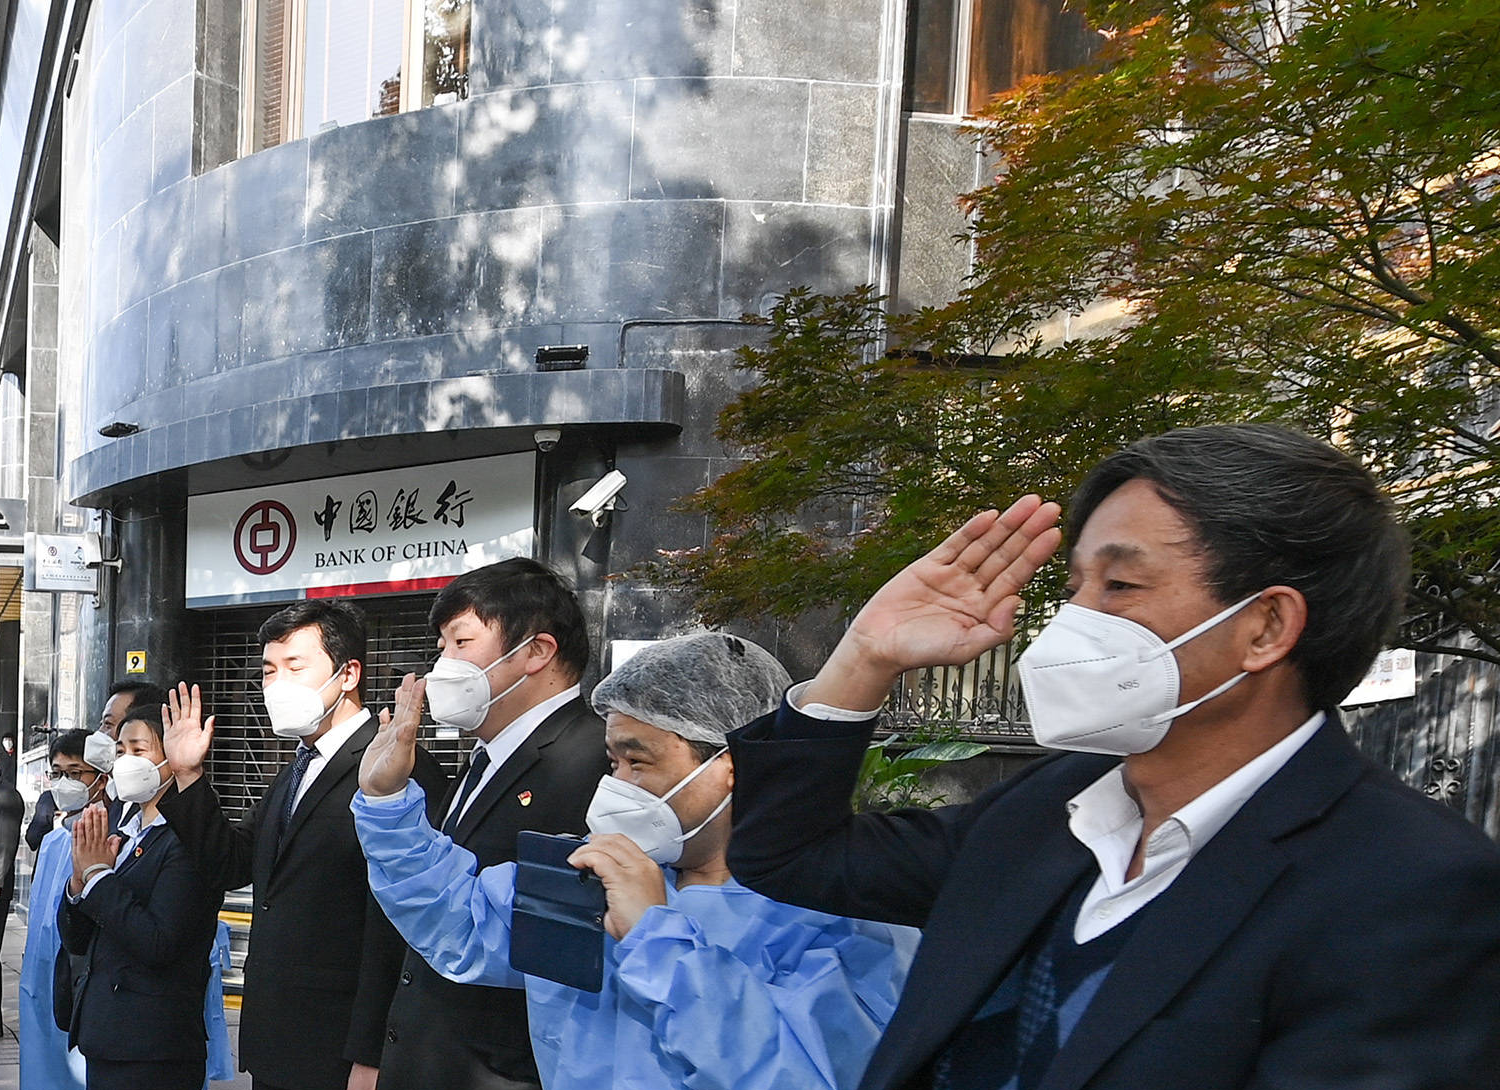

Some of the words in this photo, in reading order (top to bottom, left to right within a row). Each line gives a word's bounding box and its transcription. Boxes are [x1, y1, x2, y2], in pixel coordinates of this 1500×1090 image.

[313, 479, 475, 542] 中國銀行
[314, 549, 366, 568] BANK
[371, 545, 397, 563] OF
[402, 538, 470, 560] CHINA
[131, 655, 140, 669] 9
[1116, 679, 1141, 691] N95
